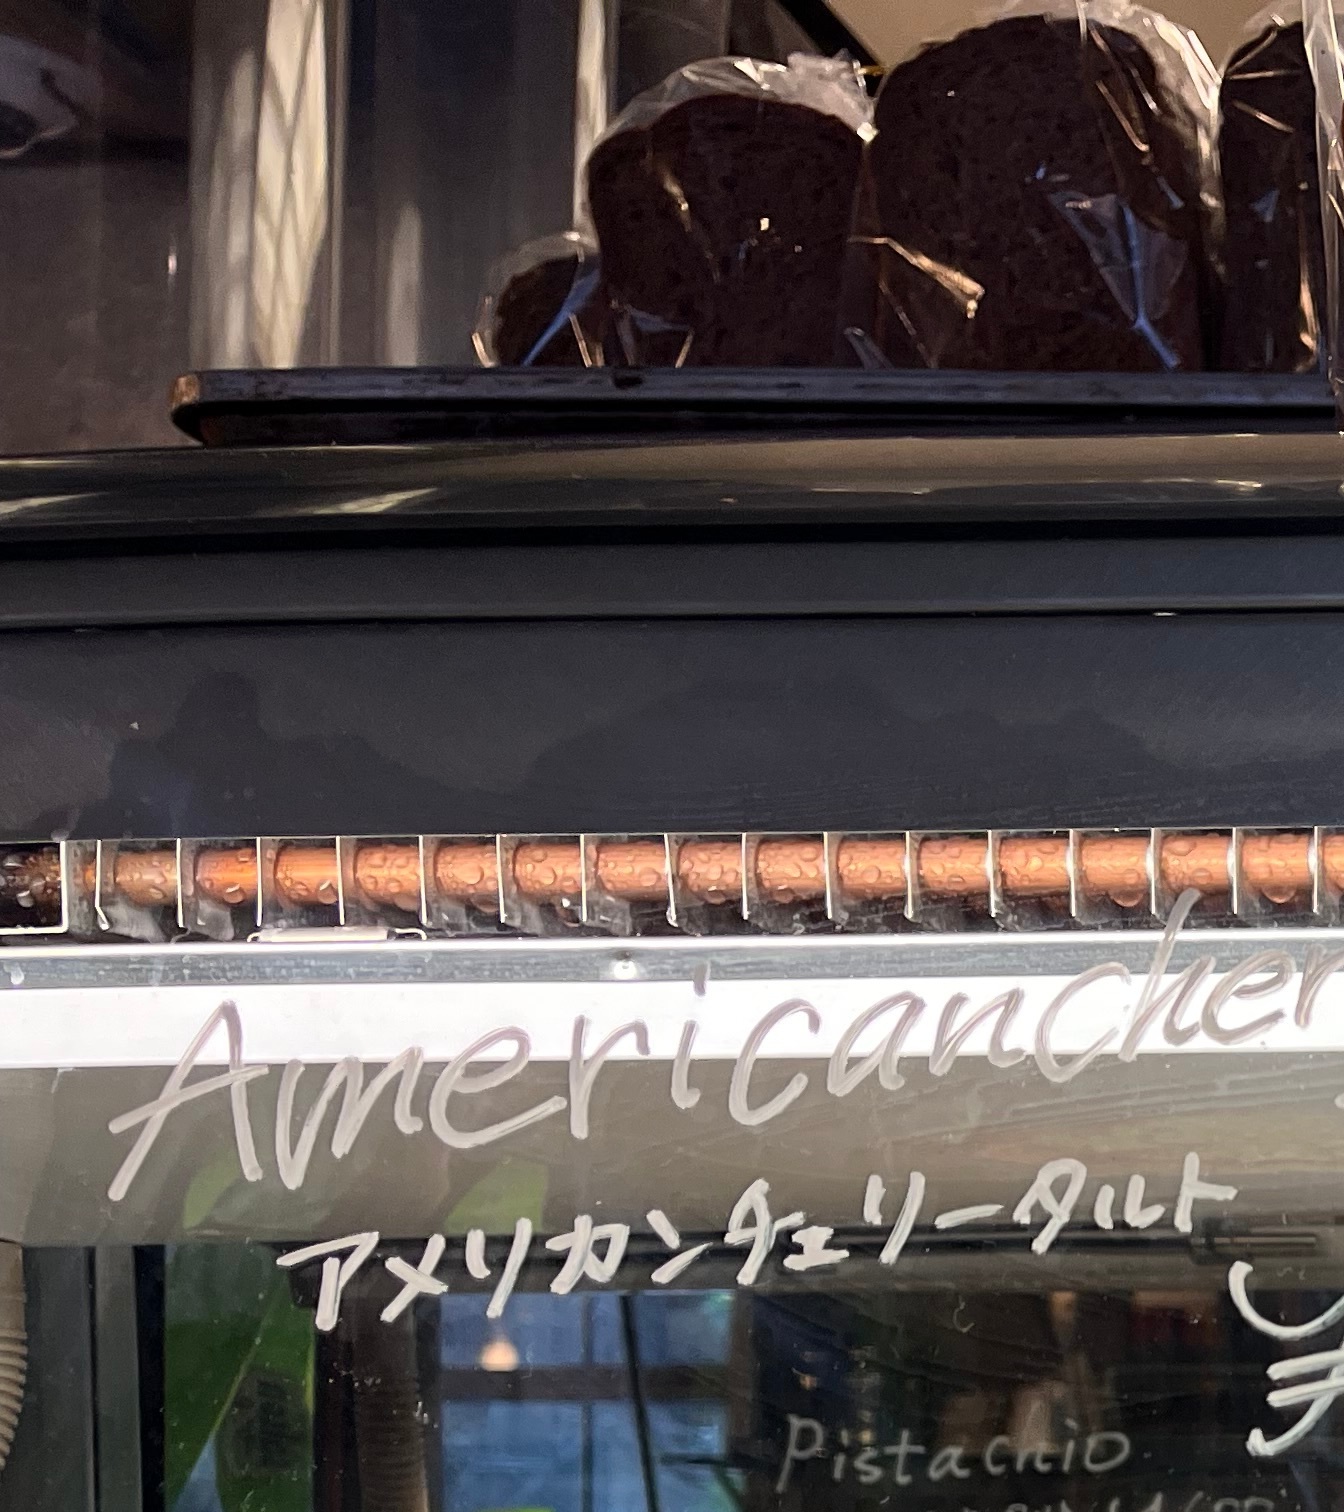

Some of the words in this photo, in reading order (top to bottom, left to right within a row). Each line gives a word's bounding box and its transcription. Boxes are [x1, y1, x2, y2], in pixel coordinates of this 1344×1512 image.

[277, 1152, 1239, 1333] アメリカンチェリータルト
